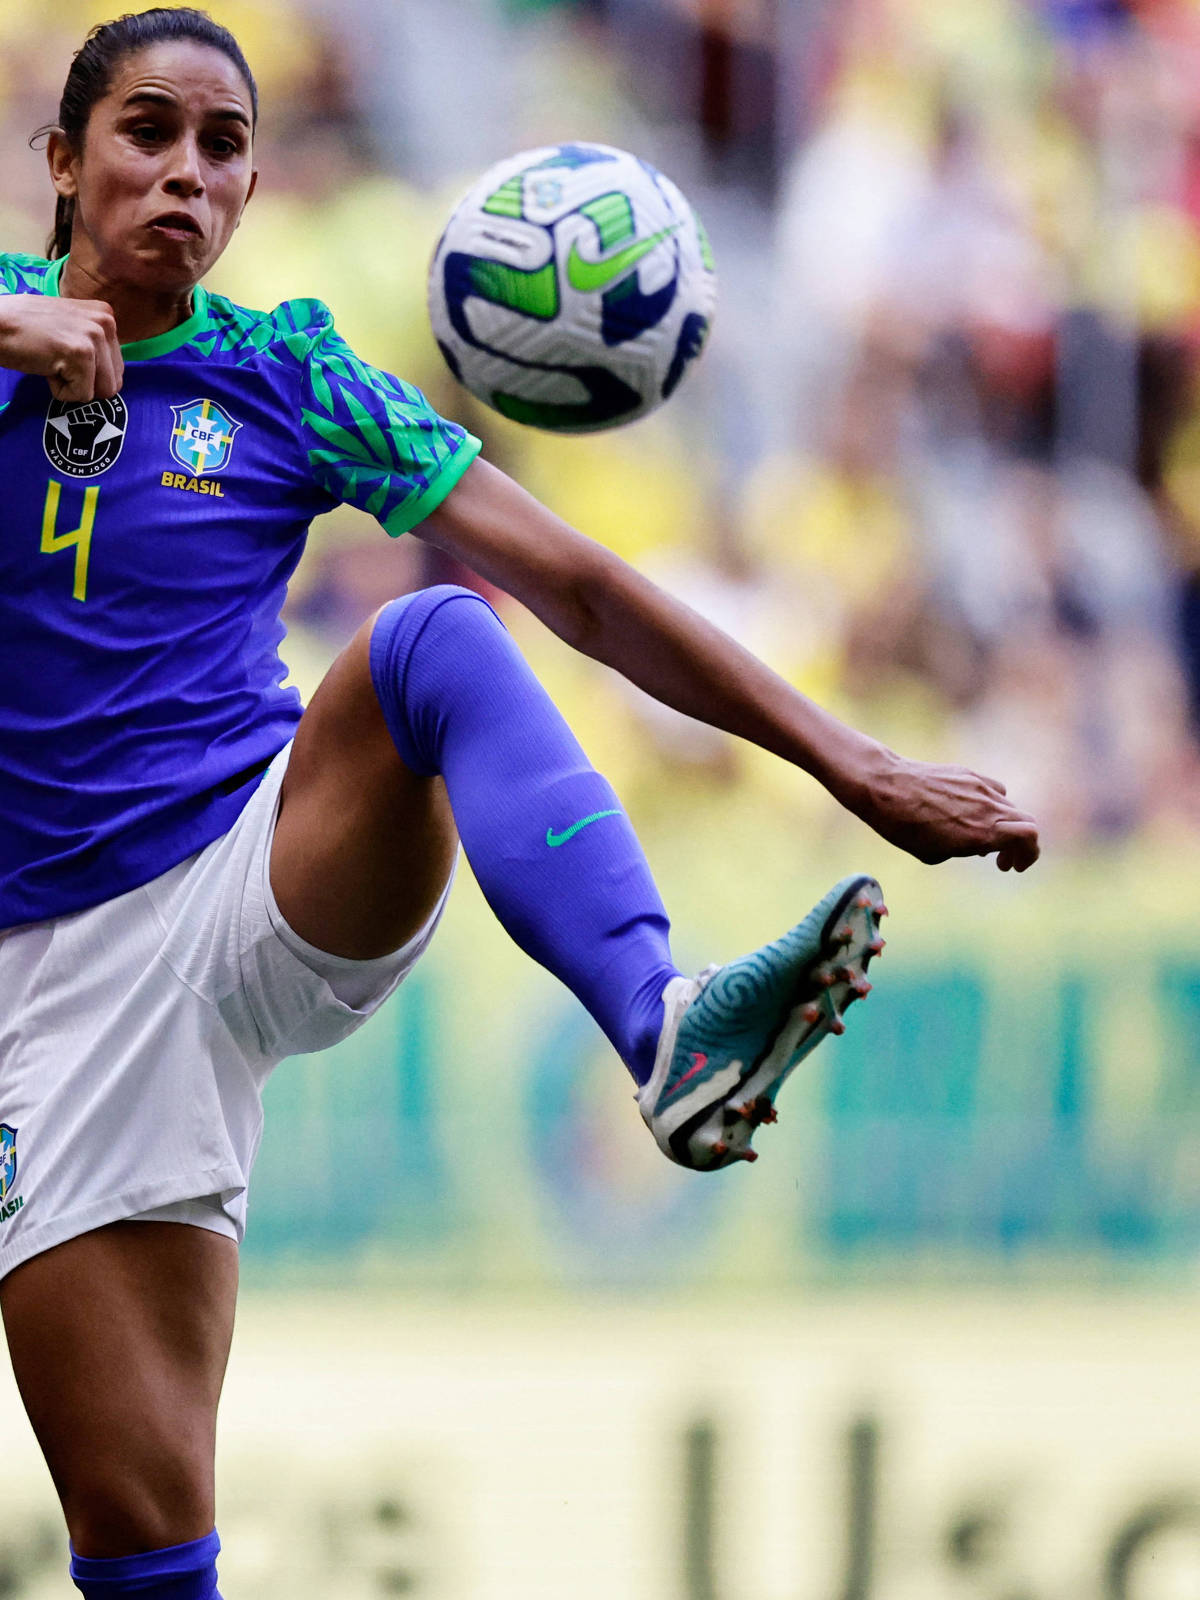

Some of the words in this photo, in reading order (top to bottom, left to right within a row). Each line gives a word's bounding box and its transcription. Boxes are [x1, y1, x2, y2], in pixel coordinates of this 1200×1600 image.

[191, 429, 216, 443] CBF
[73, 448, 88, 456] CBF
[67, 466, 84, 474] TEM
[90, 457, 110, 473] JOGO
[161, 471, 225, 498] BRASIL
[40, 478, 102, 603] 4
